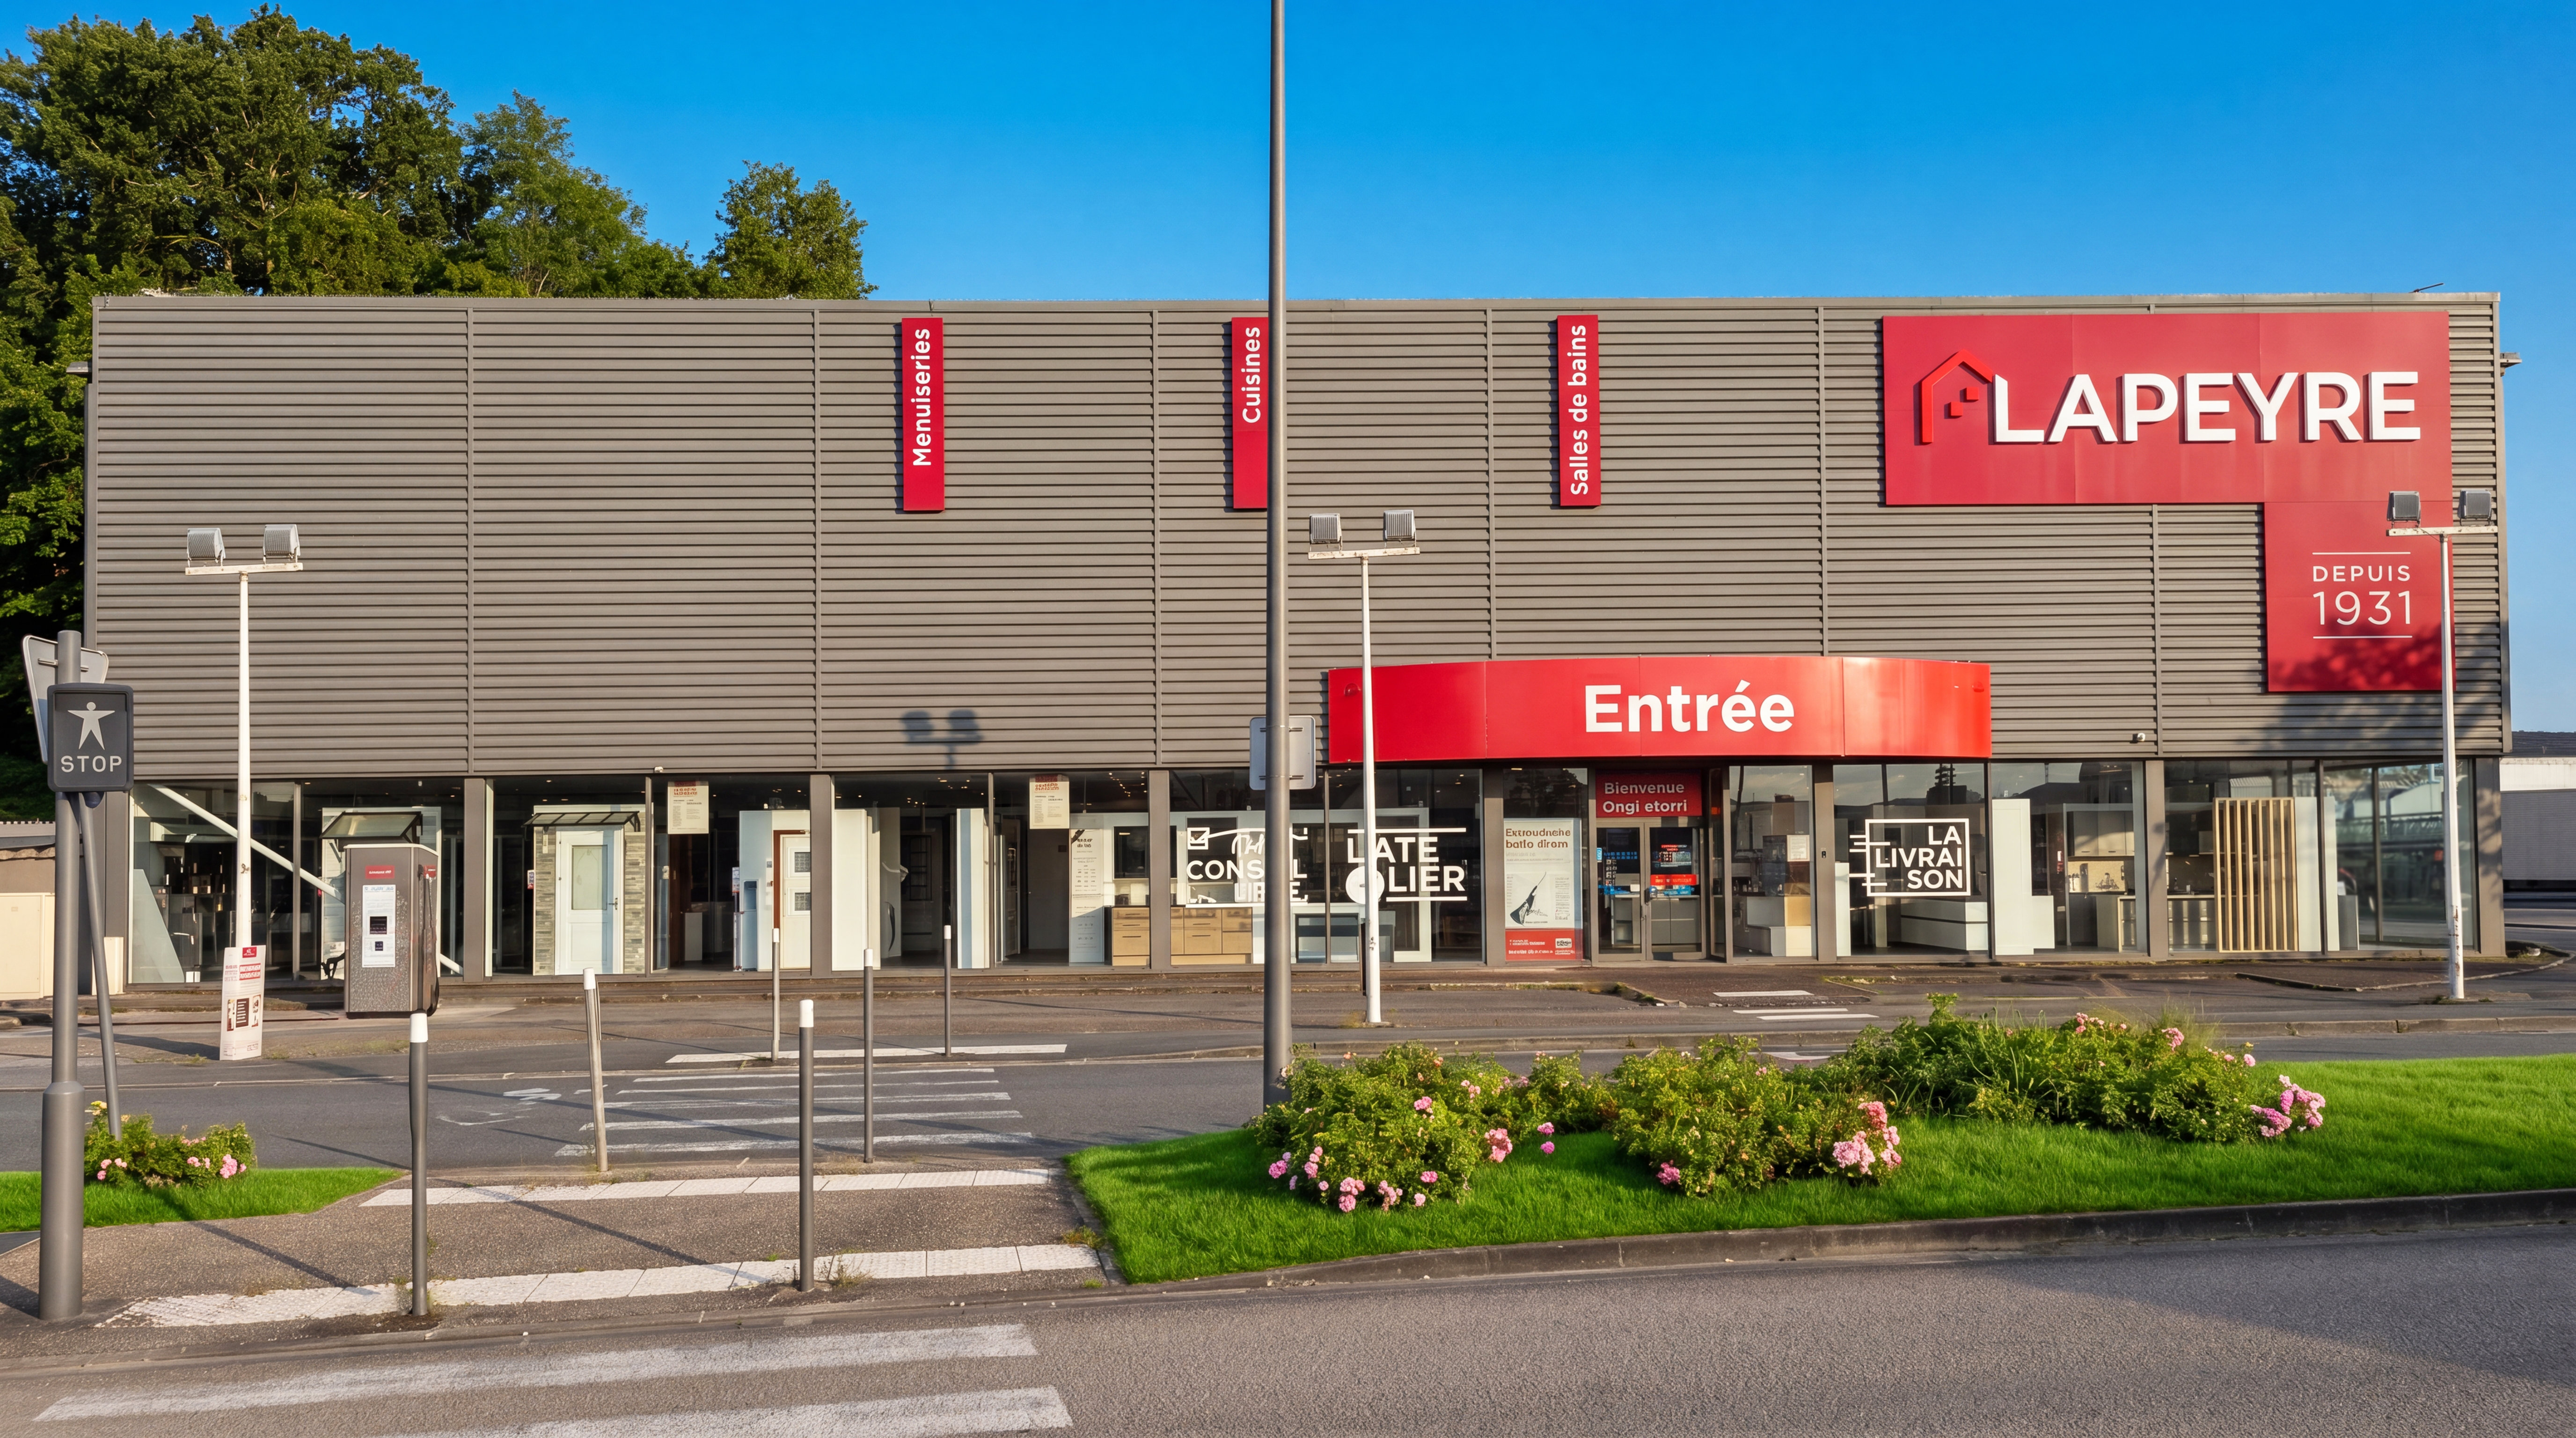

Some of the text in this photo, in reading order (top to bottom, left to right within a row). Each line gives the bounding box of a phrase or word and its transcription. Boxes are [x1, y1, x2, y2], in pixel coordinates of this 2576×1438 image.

[1241, 327, 1260, 423] Cuisines
[911, 329, 931, 466] Menuiseries
[1994, 371, 2421, 442] LAPEYRE
[1567, 325, 1588, 495] Salles de bains
[2313, 565, 2410, 582] DEPUIS
[2313, 590, 2410, 625] 1931
[1585, 679, 1794, 732] Entrée
[61, 755, 122, 773] STOP
[1604, 782, 1684, 794] Bienvenue
[1603, 800, 1687, 815] Ongi etorri
[1928, 825, 1962, 845] LA
[1875, 847, 1962, 868] LIVRAI
[1186, 859, 1308, 880] CONSL
[1907, 869, 1963, 889] SON
